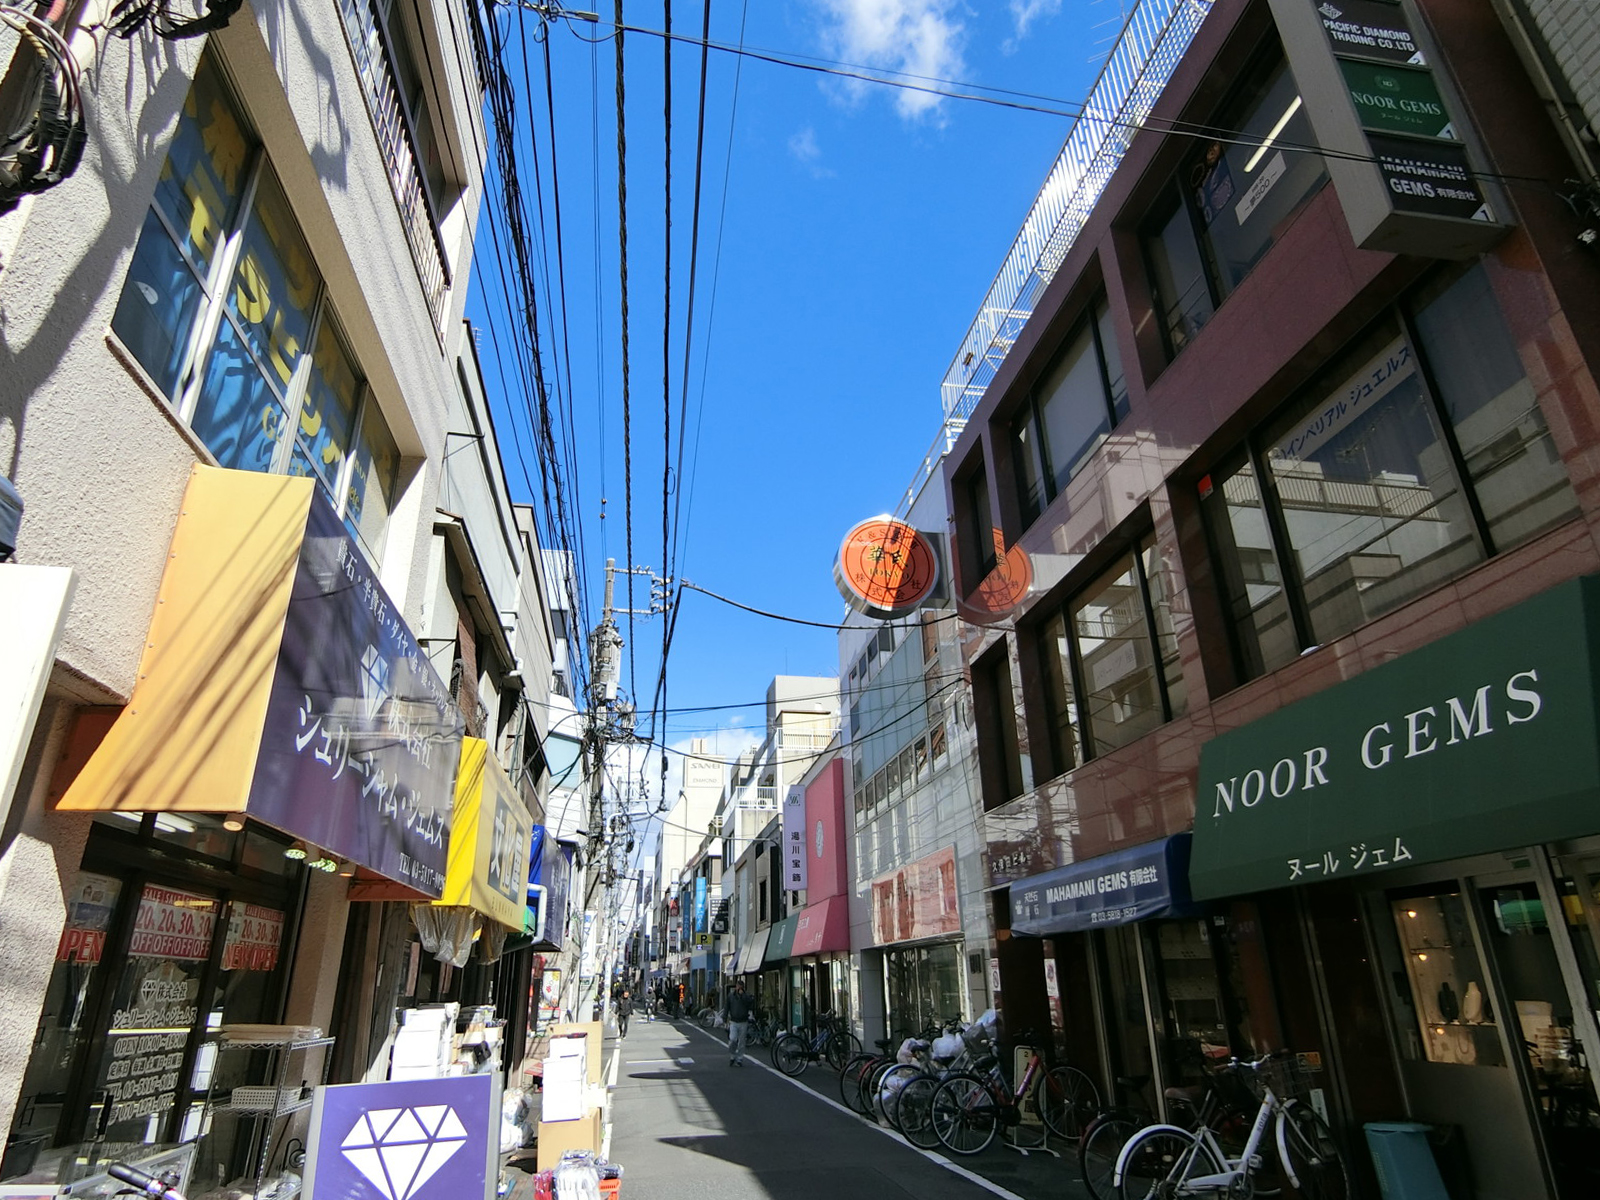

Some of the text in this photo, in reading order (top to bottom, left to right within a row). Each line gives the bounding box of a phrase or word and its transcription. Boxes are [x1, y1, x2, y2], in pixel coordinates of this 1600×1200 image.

[1322, 19, 1411, 42] PACIFIC DIAMOND
[1330, 30, 1376, 46] TRADING
[1351, 91, 1442, 116] NOOR GEMS
[1389, 177, 1436, 198] GEMS
[1350, 346, 1412, 406] ジュエルス
[1212, 669, 1542, 818] NOOR GEMS
[690, 762, 721, 770] SANEI
[1287, 836, 1413, 881] ヌール ジェム
[143, 889, 161, 901] SALE
[1046, 864, 1159, 905] MAHAMANI GEMS 有限会社
[131, 933, 210, 957] OFF OFF OFF OFF
[156, 982, 188, 1003] 株式会社
[114, 1036, 139, 1058] OPEN
